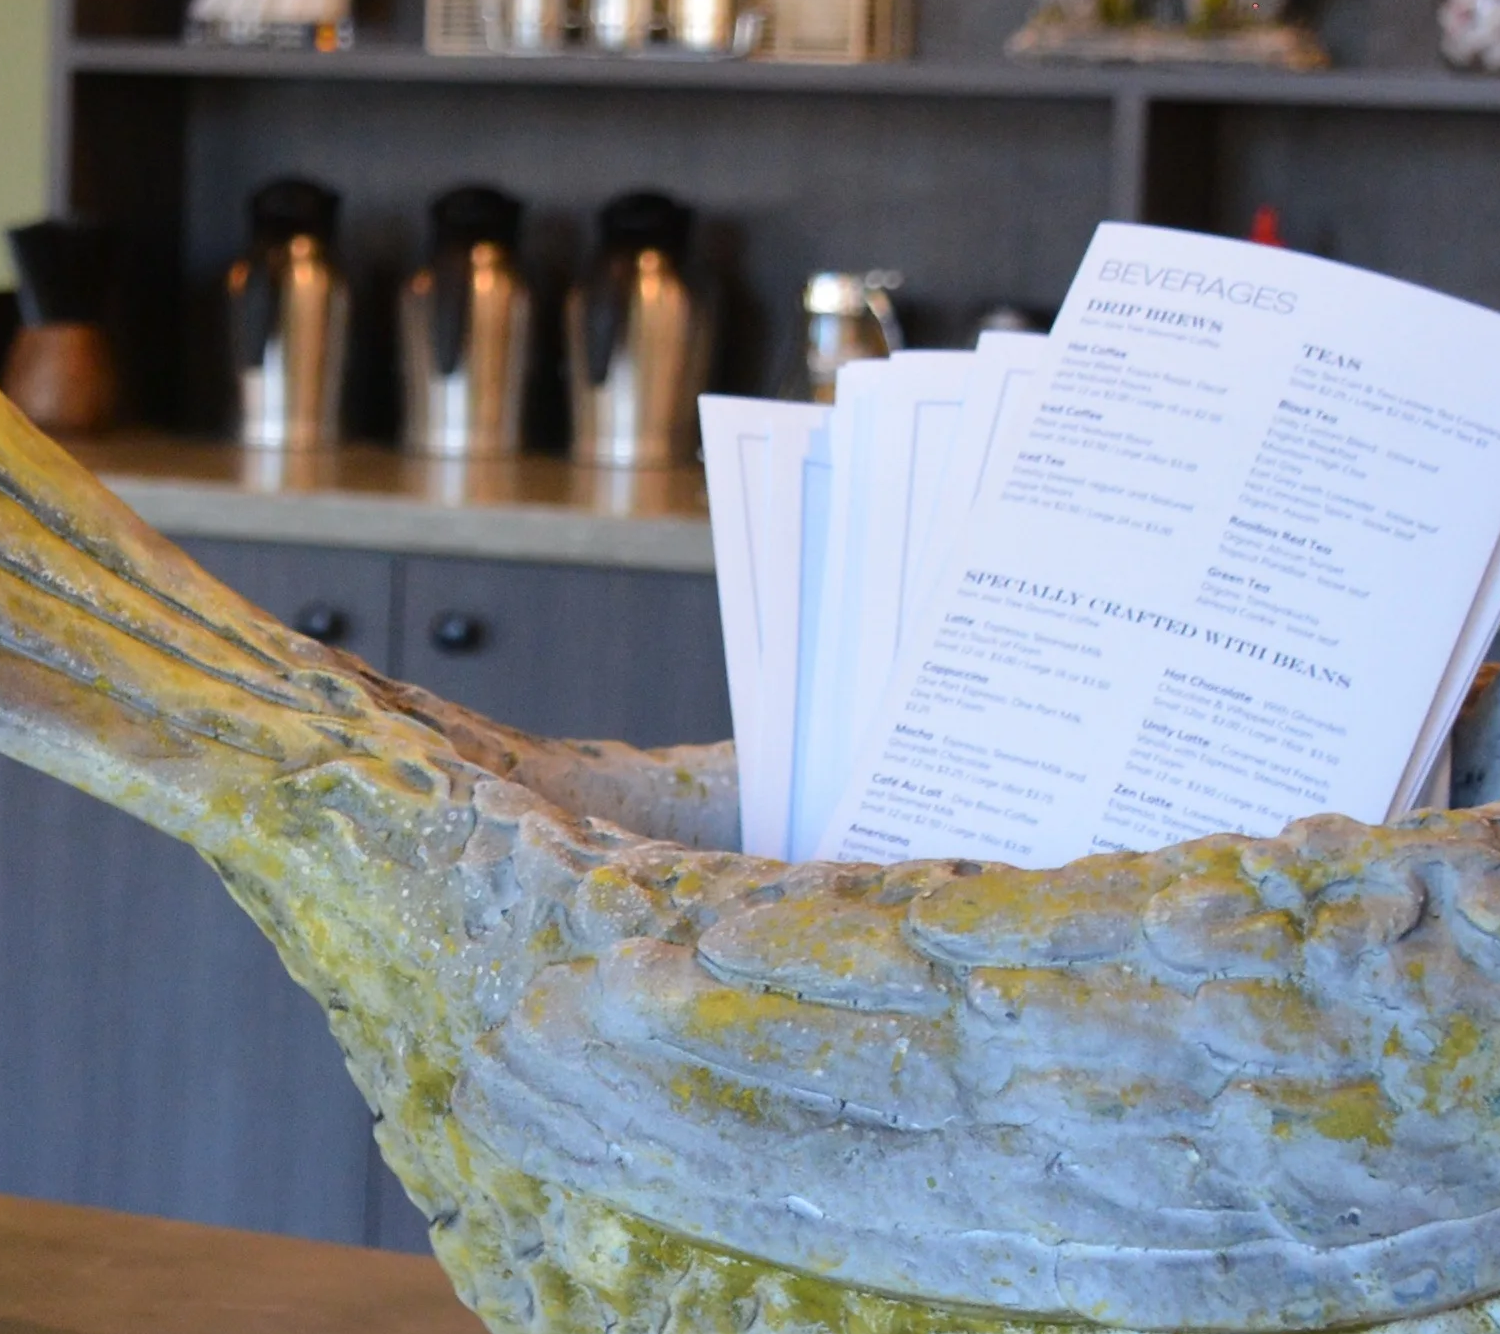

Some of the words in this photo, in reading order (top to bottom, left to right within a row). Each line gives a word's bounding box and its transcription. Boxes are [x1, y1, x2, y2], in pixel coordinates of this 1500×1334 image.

[1097, 259, 1299, 316] BEVERAGES
[1086, 298, 1142, 321] DRIP
[1144, 308, 1224, 334] BREWS
[1089, 343, 1127, 360] Coffee
[1301, 342, 1362, 372] TEAS
[1040, 401, 1063, 416] Iced
[1064, 405, 1104, 423] Coffee
[1277, 398, 1310, 419] Black
[1314, 408, 1338, 426] Tea
[1017, 450, 1041, 465] Iced
[1043, 454, 1067, 469] Tea
[1228, 514, 1278, 540] Rooibos
[1281, 529, 1306, 548] Red
[1309, 538, 1333, 556] Tea
[1207, 565, 1245, 587] Green
[1246, 576, 1271, 595] Tea
[964, 569, 1084, 608] SPECIALLY
[1088, 596, 1198, 639] CRAFTED
[1204, 628, 1268, 661] WITH
[1272, 650, 1352, 690] BEANS
[1162, 666, 1186, 684] Hot
[1188, 675, 1253, 706] Chocolate
[894, 721, 933, 742] Mocha
[1141, 719, 1175, 740] Unity
[1176, 730, 1209, 751] Latte
[900, 780, 917, 795] Au
[917, 785, 942, 802] Lait
[1113, 783, 1137, 801] Zen
[1139, 791, 1172, 812] Latte
[848, 821, 911, 848] Americano
